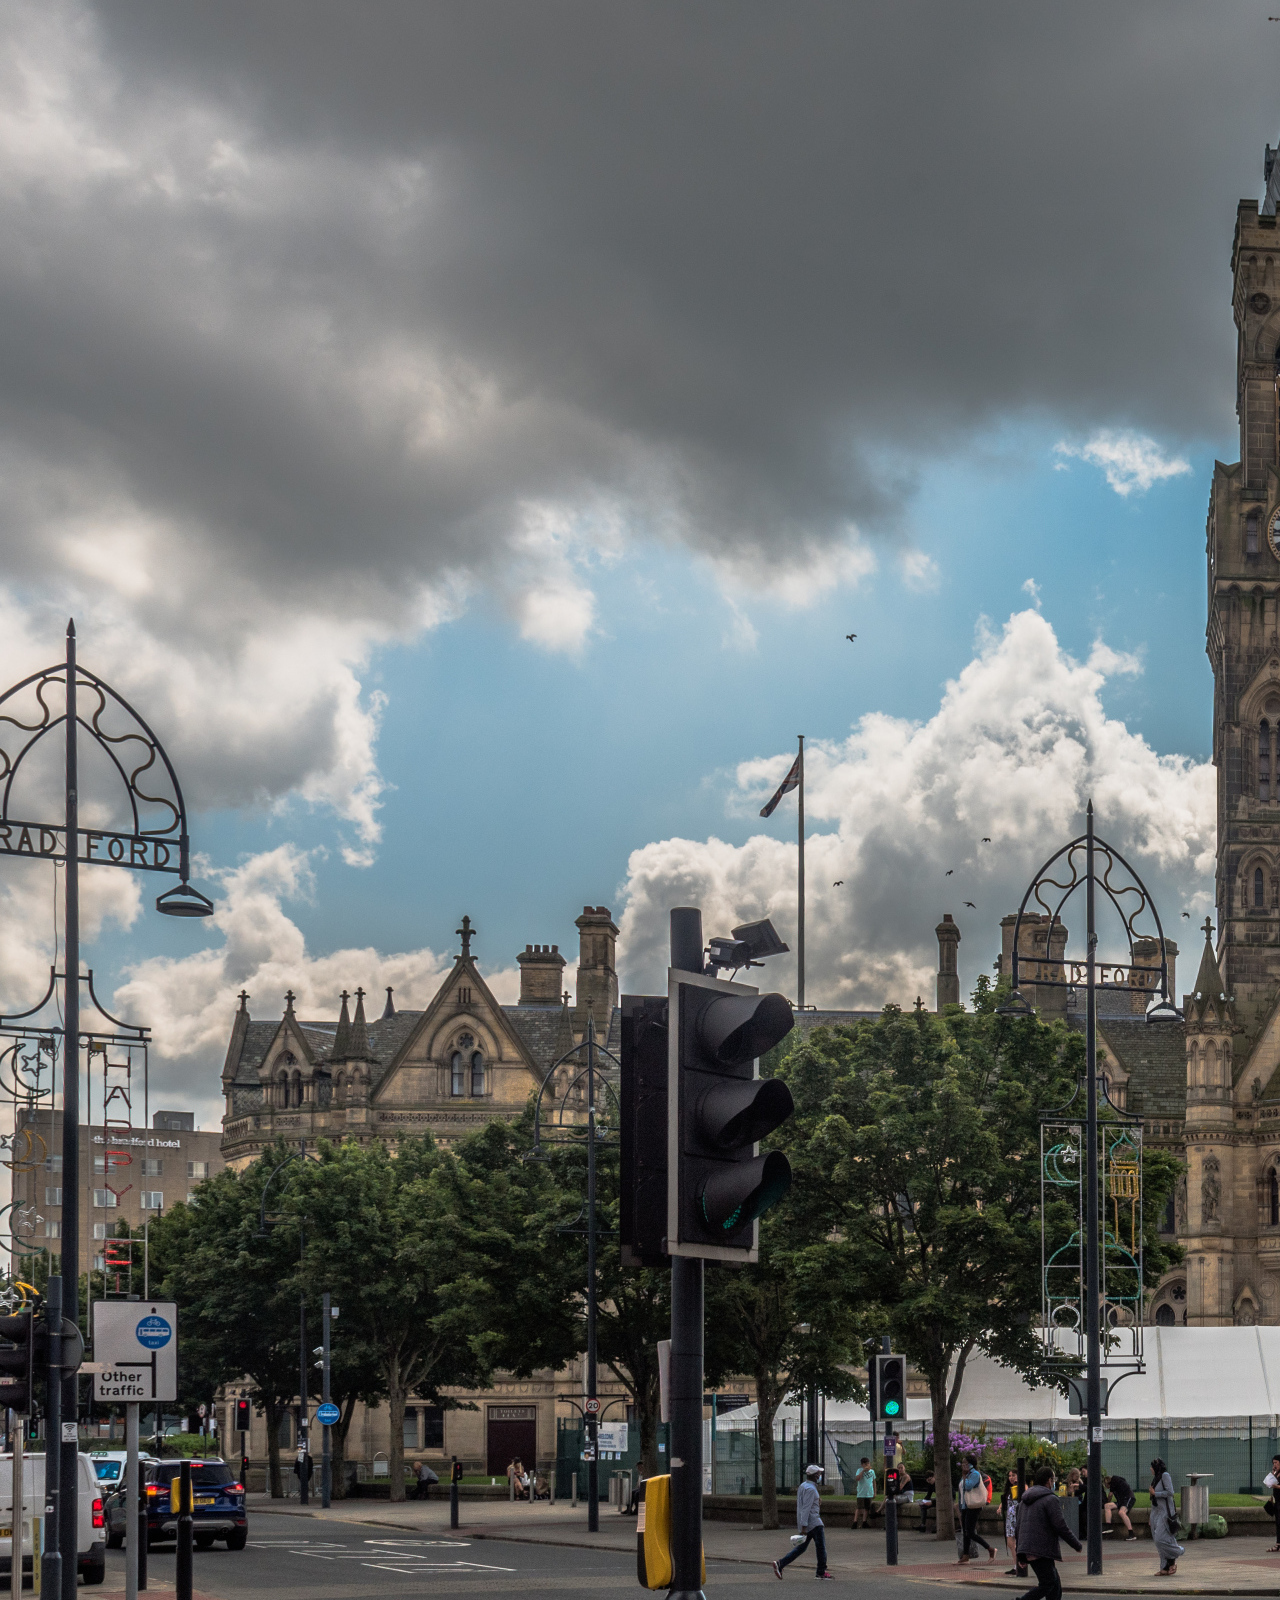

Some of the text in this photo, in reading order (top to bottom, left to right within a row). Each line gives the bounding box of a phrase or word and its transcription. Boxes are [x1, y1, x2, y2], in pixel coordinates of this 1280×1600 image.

[155, 1138, 181, 1148] hotel
[101, 1371, 142, 1382] Other
[100, 1385, 144, 1396] traffic
